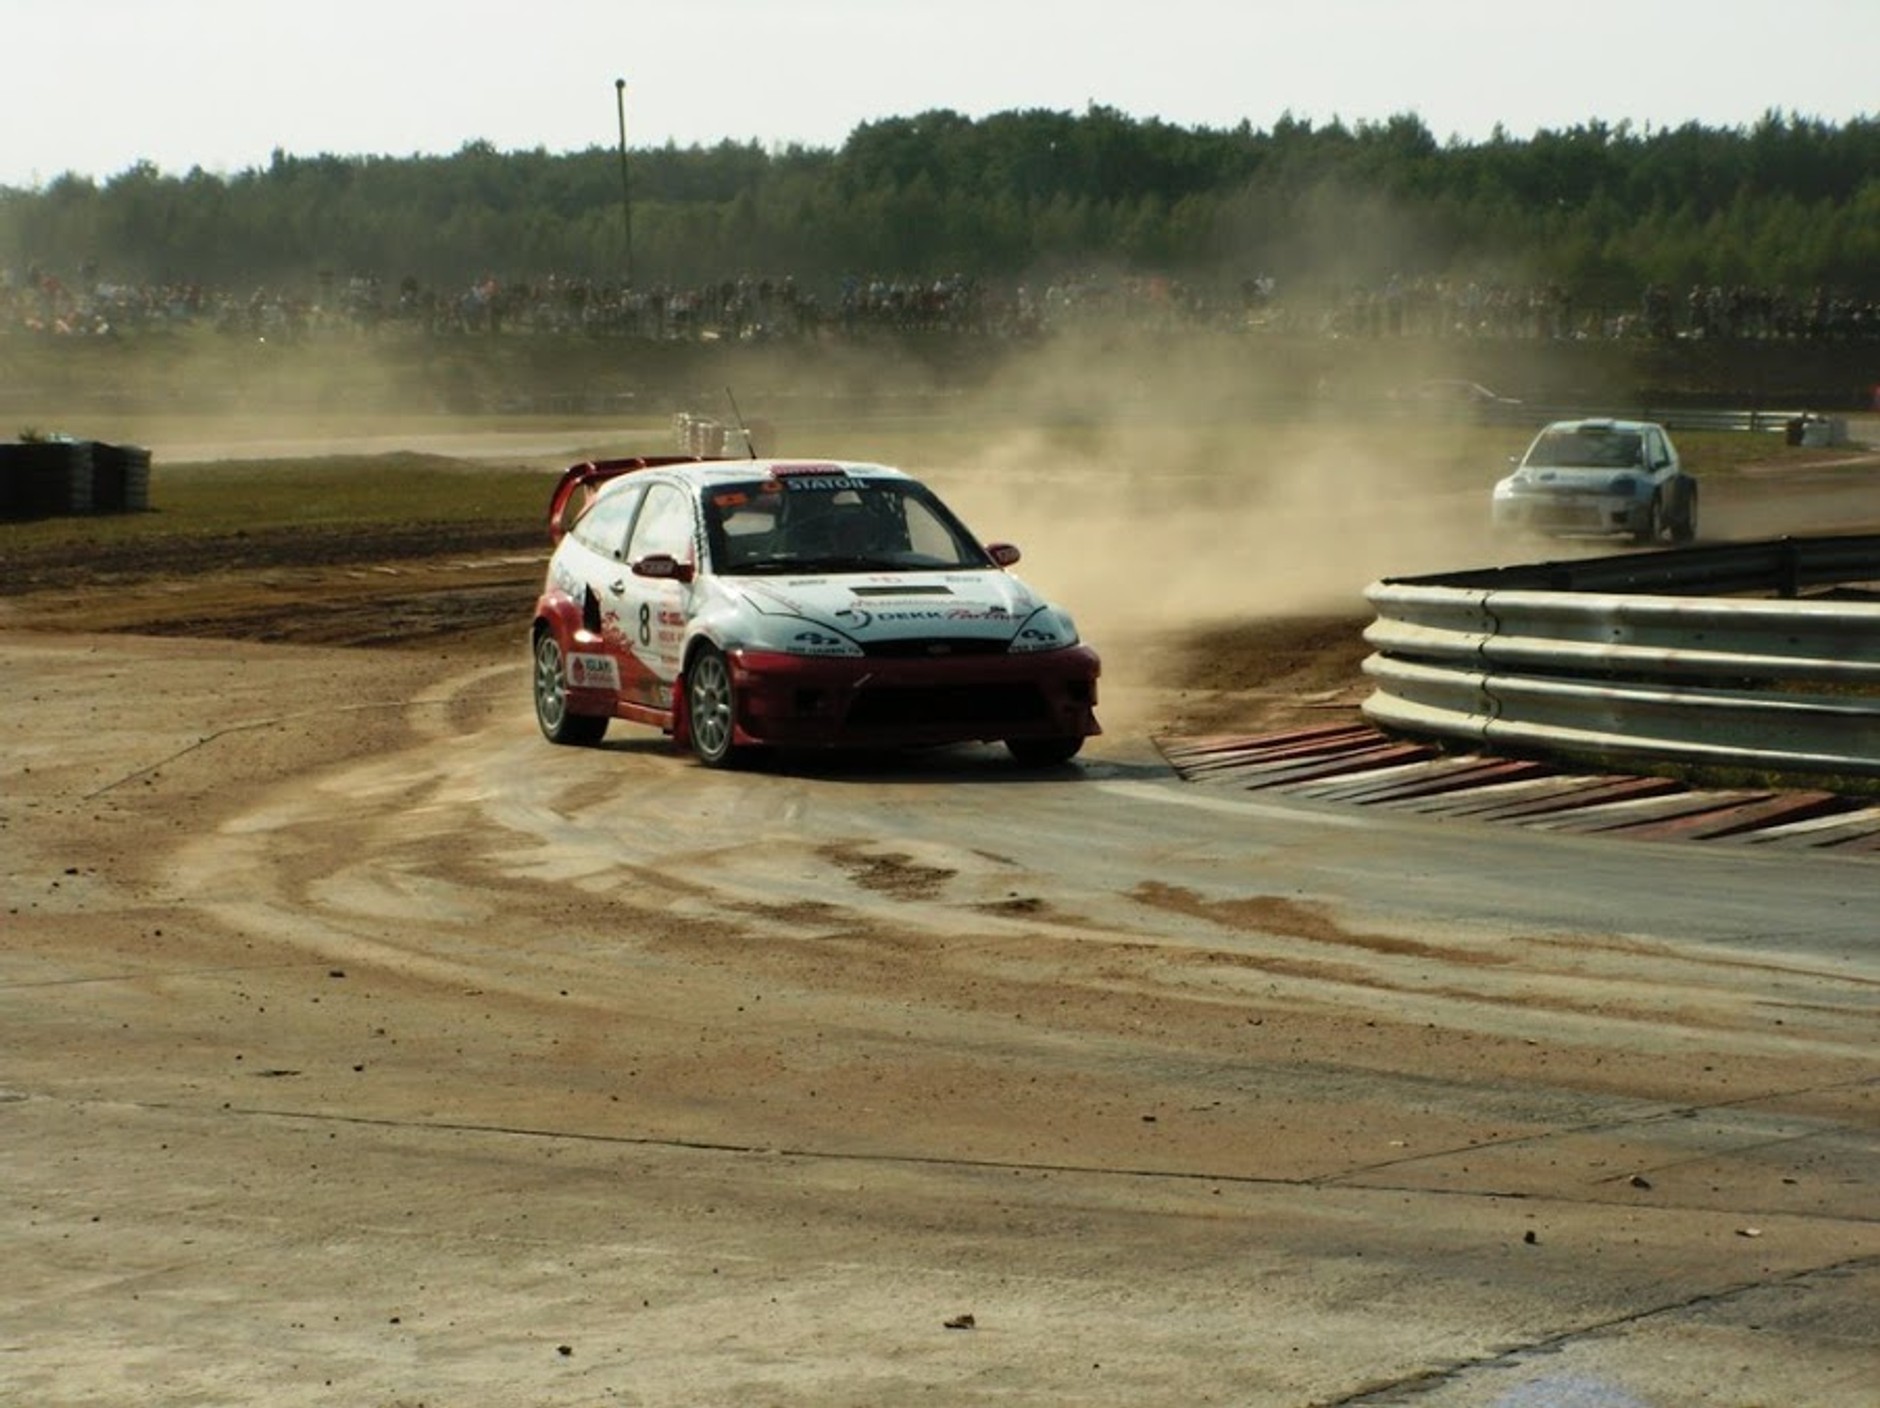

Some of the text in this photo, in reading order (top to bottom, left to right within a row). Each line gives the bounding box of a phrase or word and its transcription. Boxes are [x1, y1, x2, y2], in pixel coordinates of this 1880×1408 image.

[787, 478, 870, 490] STATOIL
[877, 611, 943, 621] DEKK
[639, 602, 650, 647] 8
